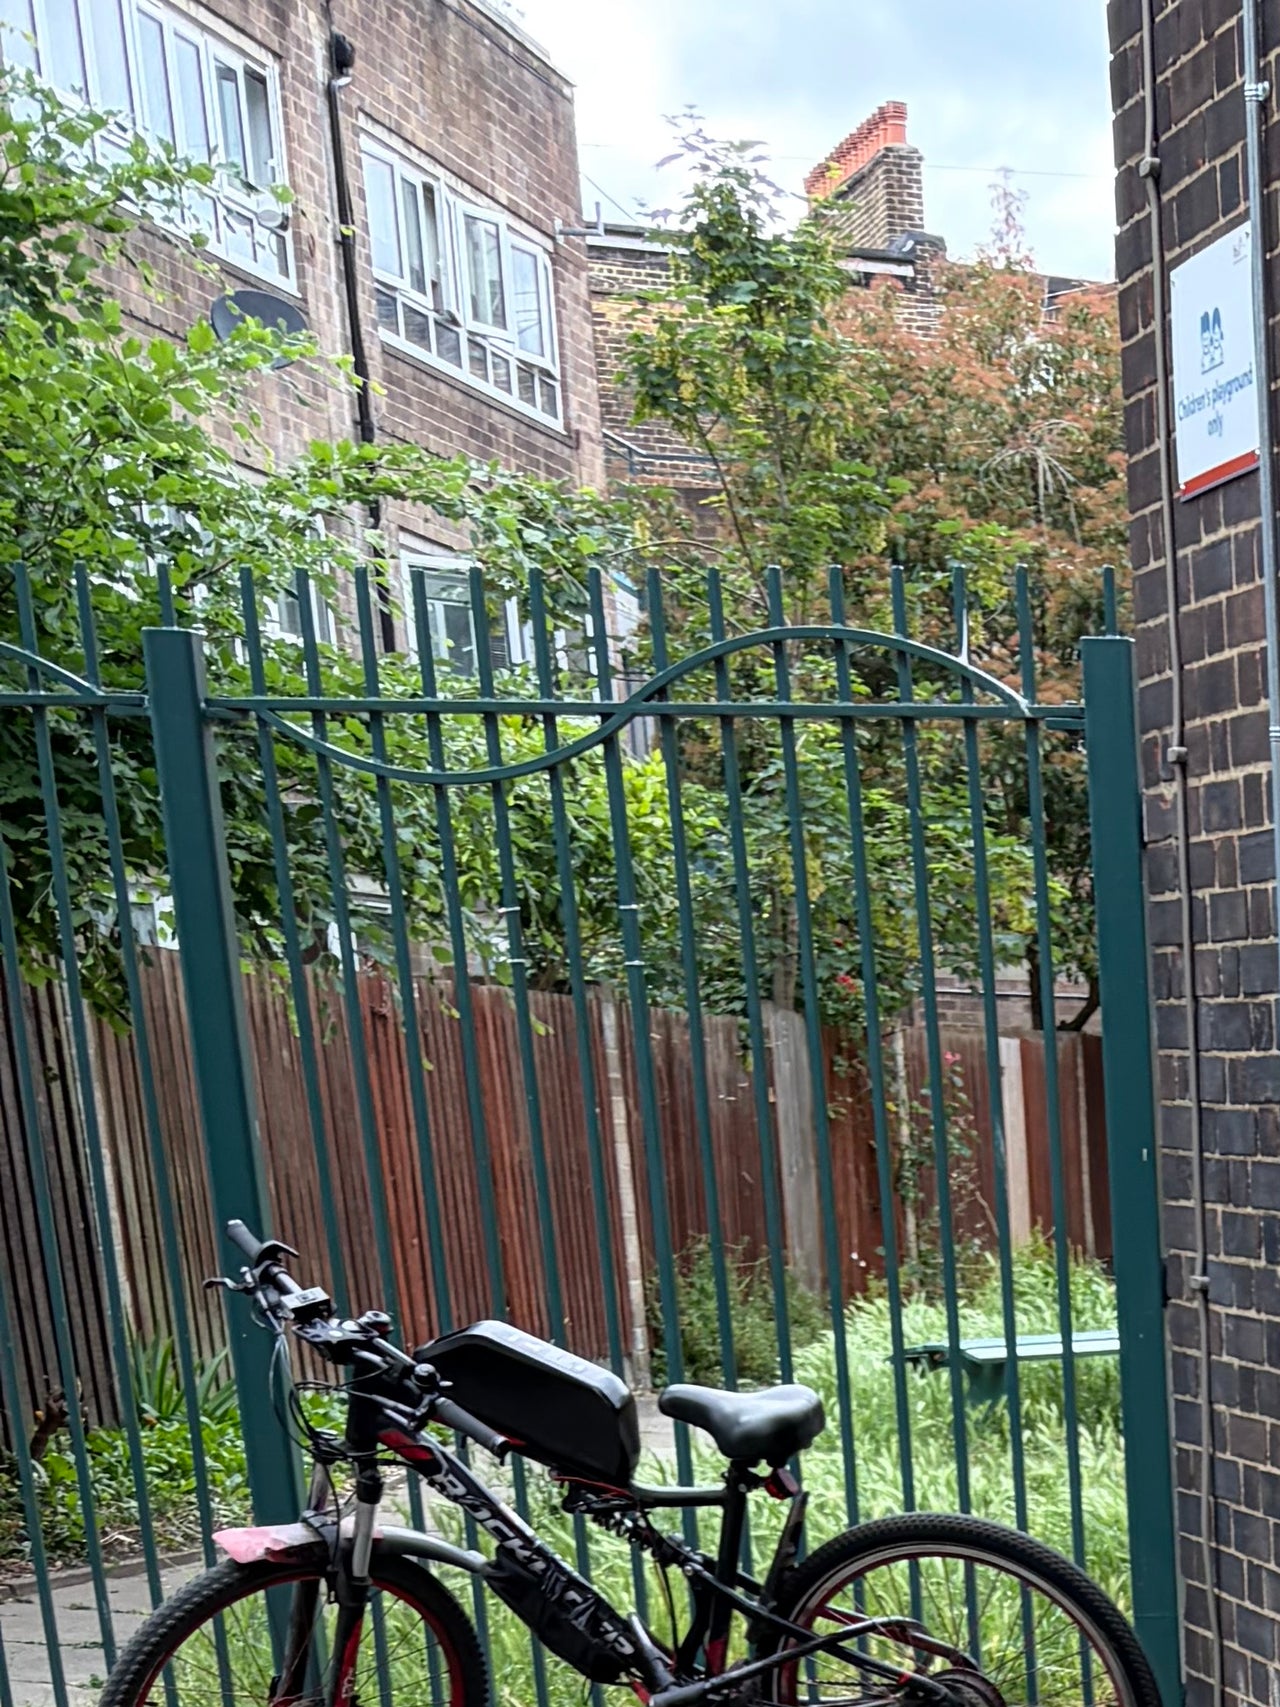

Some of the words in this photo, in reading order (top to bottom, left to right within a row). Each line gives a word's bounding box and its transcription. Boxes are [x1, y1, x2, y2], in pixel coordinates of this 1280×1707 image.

[1178, 386, 1211, 421] Children's
[1212, 361, 1253, 410] playground
[1207, 409, 1223, 437] only
